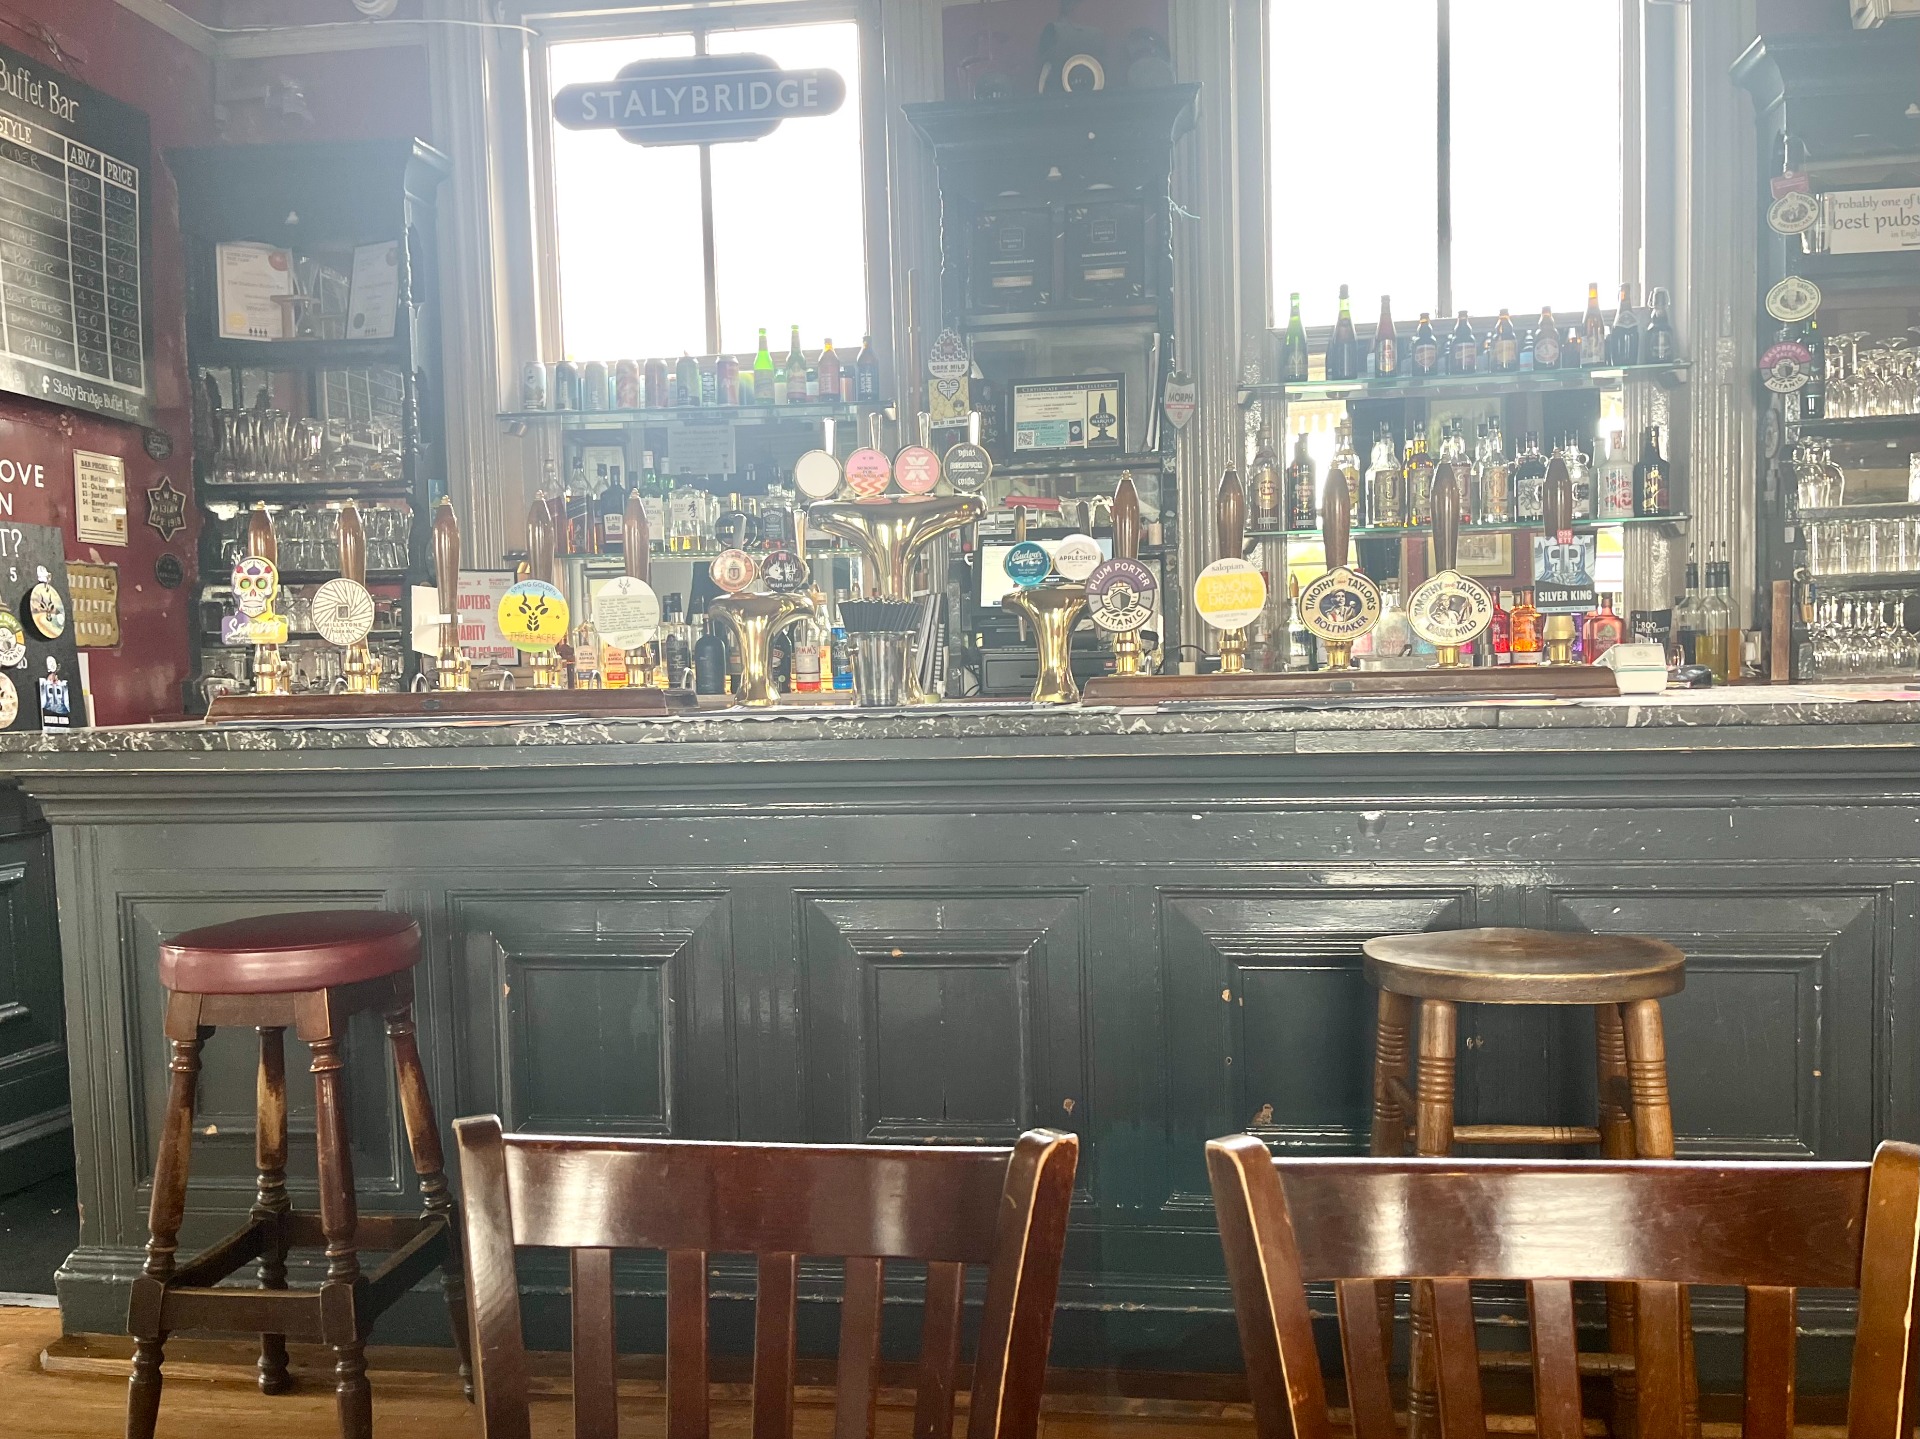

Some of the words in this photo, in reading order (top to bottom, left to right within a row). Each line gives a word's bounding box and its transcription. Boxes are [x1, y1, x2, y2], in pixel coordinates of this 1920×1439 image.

[0, 58, 44, 108] Buffet
[48, 80, 79, 123] Bar
[581, 78, 819, 121] STALYBRIDGE
[106, 161, 133, 187] PRICE
[1881, 199, 1901, 208] one
[1903, 194, 1914, 209] of
[1834, 212, 1870, 230] best
[1874, 208, 1920, 234] pubs
[1763, 345, 1805, 362] RASPBERRY
[1770, 377, 1804, 389] TITANIC
[53, 378, 76, 401] Staly
[77, 385, 103, 410] Bridge
[1168, 392, 1194, 402] MORPH
[0, 459, 44, 488] OVE
[1090, 564, 1113, 591] PLUM
[1114, 562, 1150, 587] PORTER
[1211, 563, 1244, 573] salopian
[511, 582, 532, 594] SPRING
[532, 582, 557, 596] GOLDEN
[1305, 578, 1336, 611] TIMOTHY
[1347, 577, 1376, 611] TAYLOR'S
[1456, 581, 1486, 613] TAYLOR'S
[1539, 590, 1568, 602] SILVER
[1570, 590, 1593, 601] KING
[457, 594, 490, 610] APTERS
[1207, 592, 1252, 607] DREAM
[1414, 581, 1443, 617] TIMOTHY
[1101, 610, 1144, 626] TITANIC
[1313, 616, 1369, 633] BOLTMAKER
[457, 624, 486, 640] ARITY
[510, 631, 534, 641] THREE
[1426, 624, 1453, 638] DARK
[1455, 619, 1477, 637] MILD
[0, 646, 22, 661] ITANIC
[796, 645, 817, 655] PIMM'S
